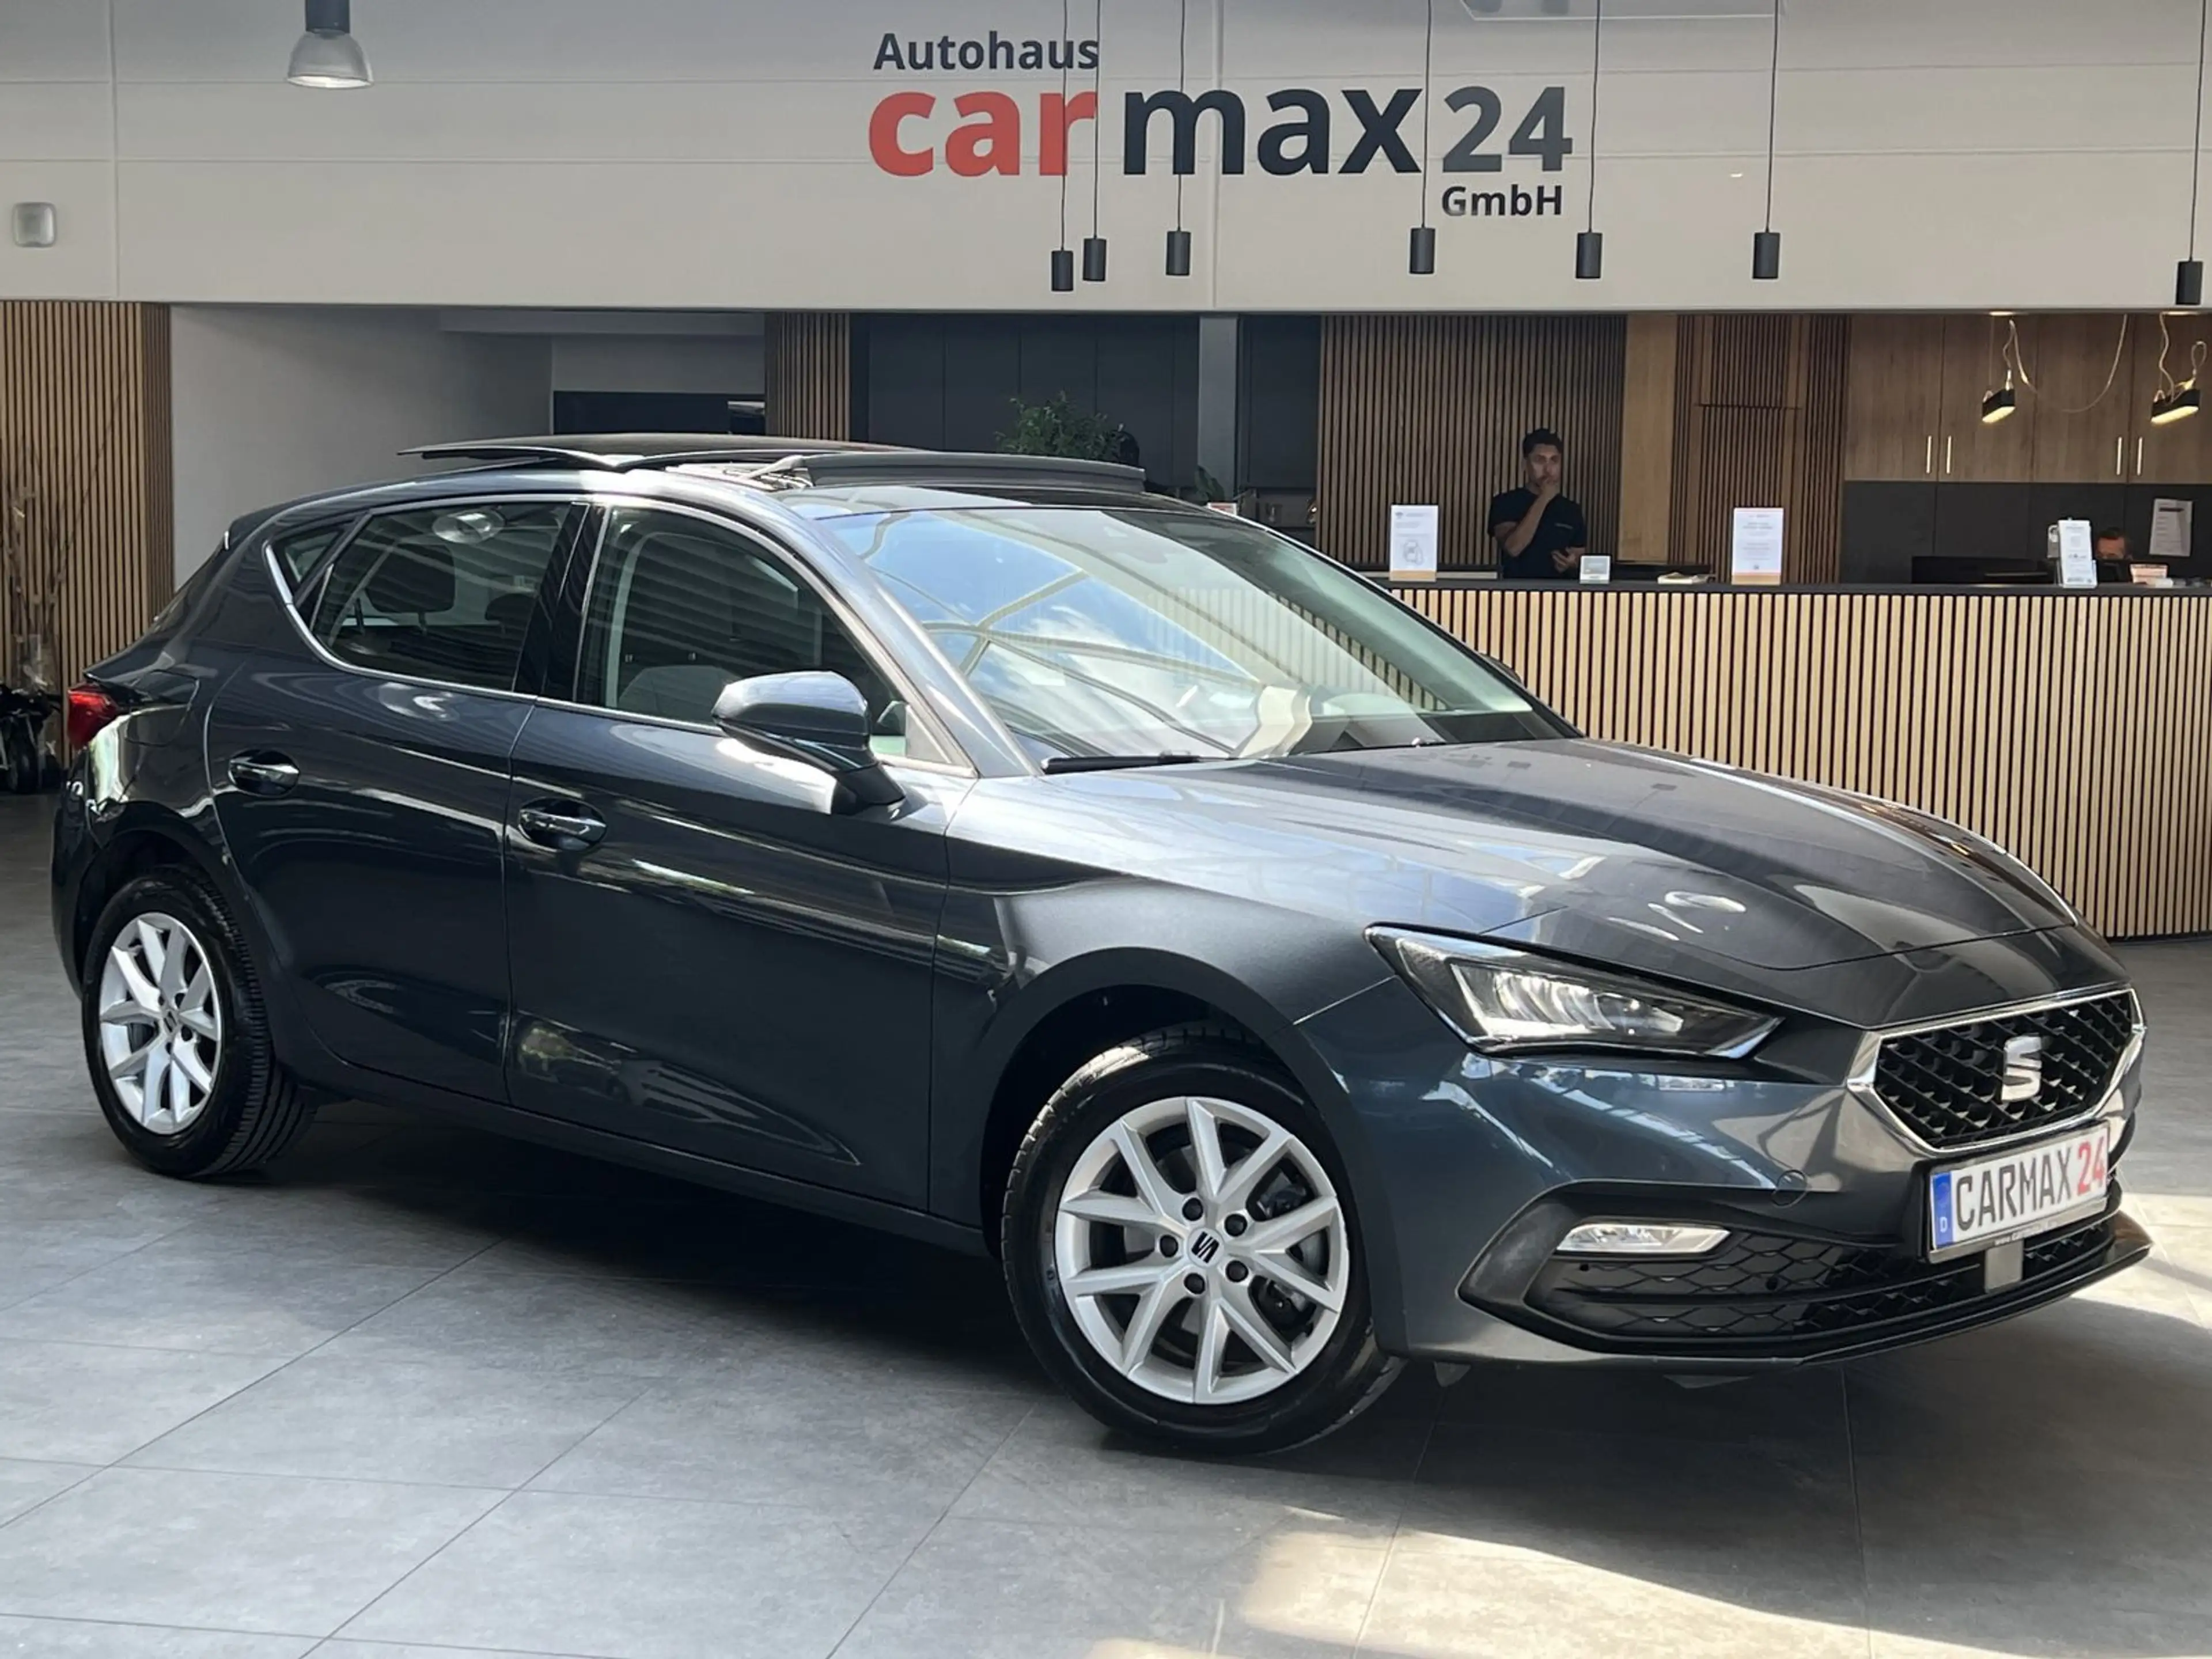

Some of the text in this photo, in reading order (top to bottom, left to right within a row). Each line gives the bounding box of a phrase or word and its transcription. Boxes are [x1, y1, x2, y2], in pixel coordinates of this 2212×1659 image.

[873, 31, 1099, 70] Autohaus
[1442, 184, 1562, 217] GmbH
[1940, 1216, 1948, 1233] D
